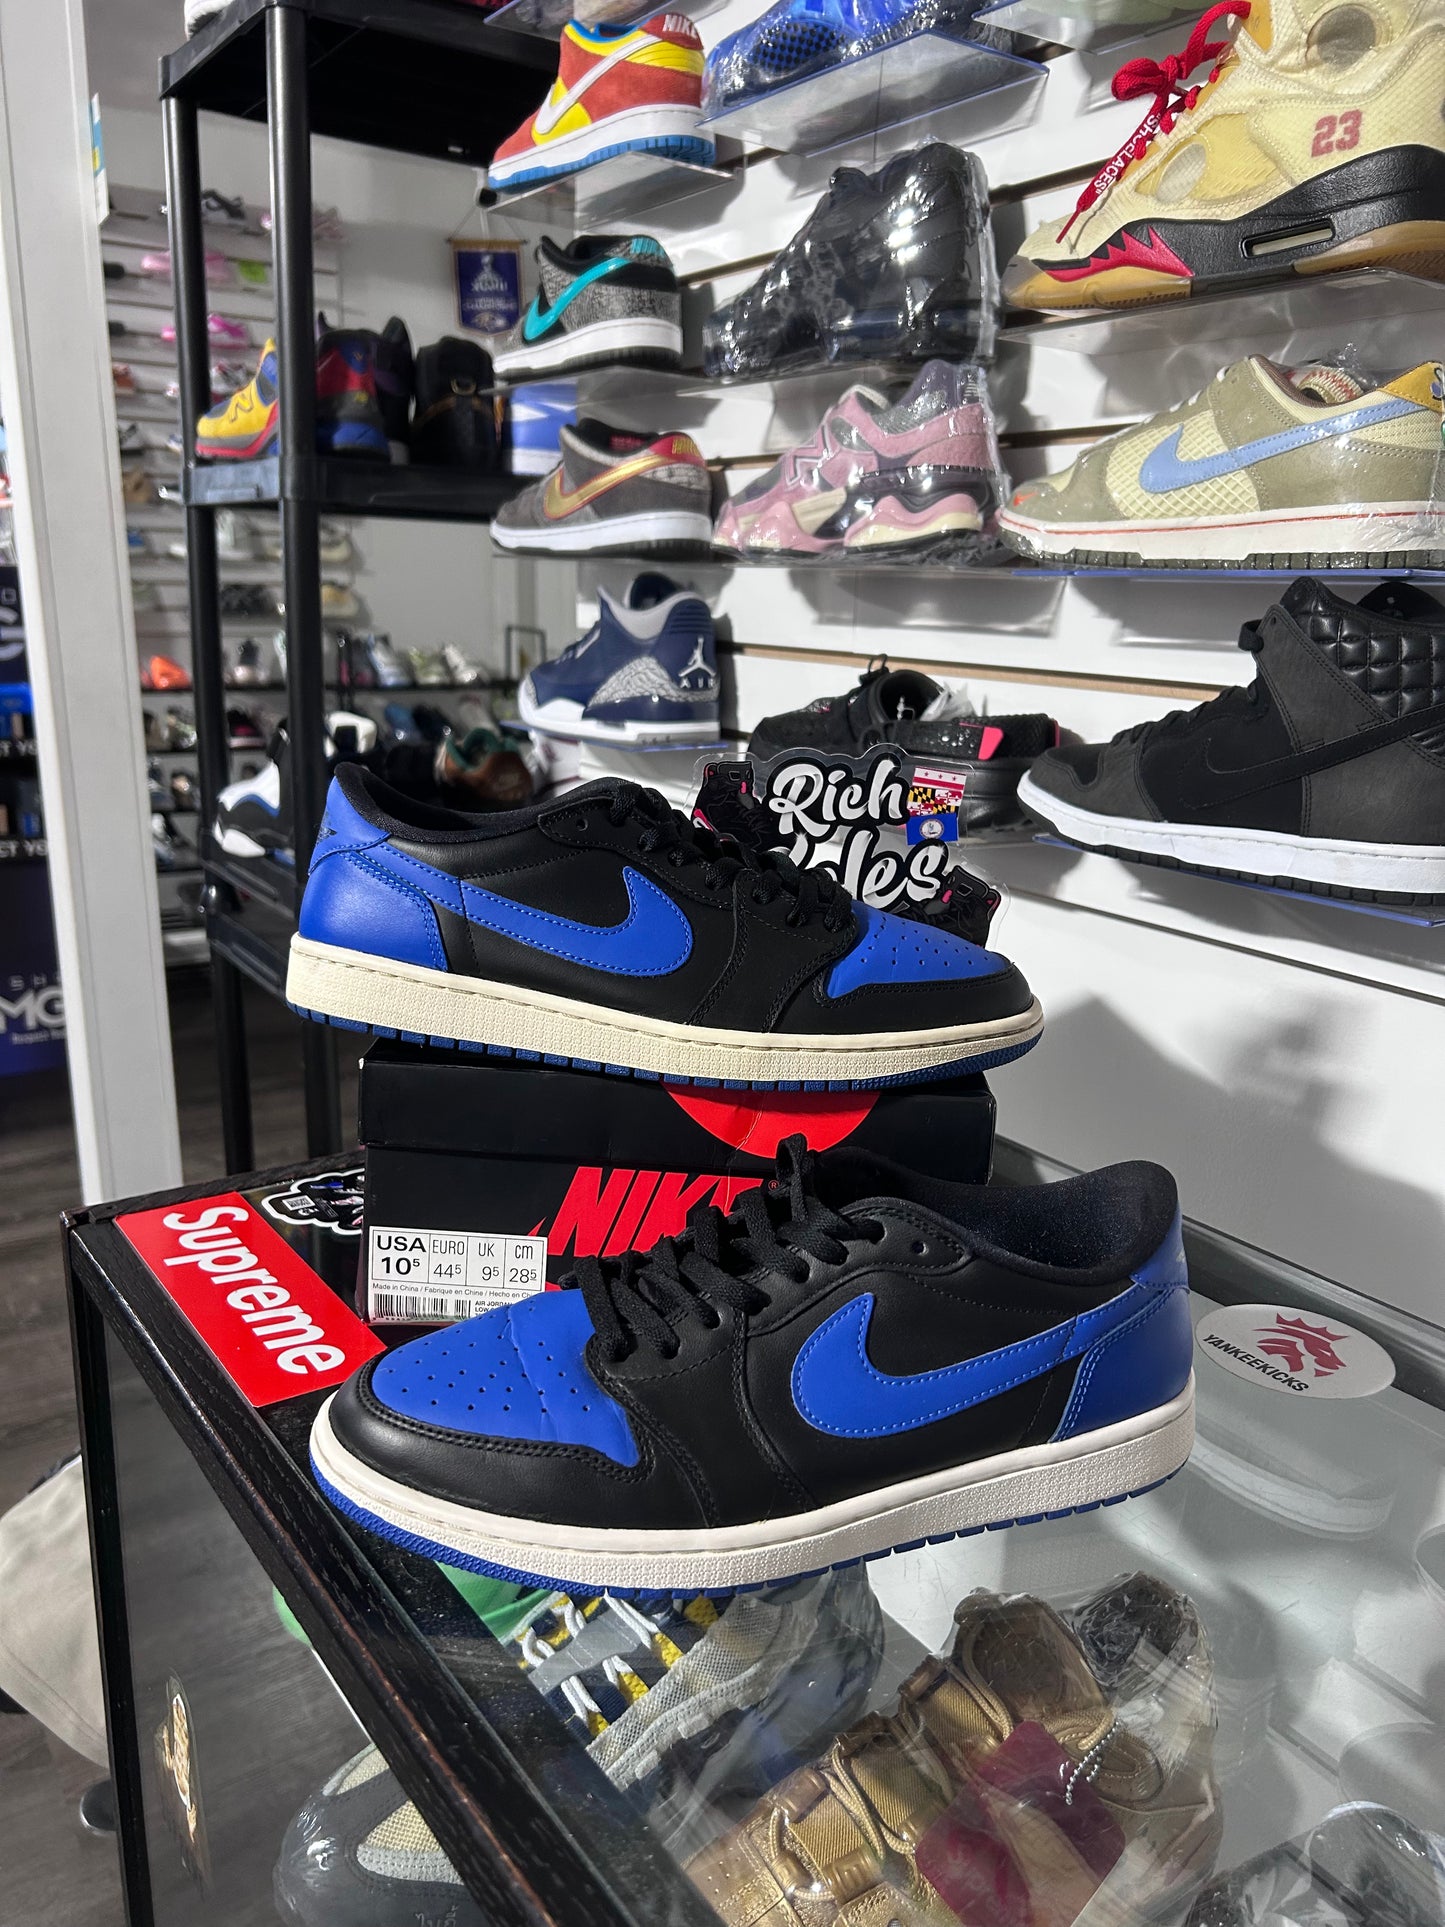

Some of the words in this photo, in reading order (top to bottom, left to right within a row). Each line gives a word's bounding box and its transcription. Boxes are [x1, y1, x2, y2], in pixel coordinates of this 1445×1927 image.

[1310, 108, 1363, 158] 23
[768, 758, 903, 838] Rich
[376, 1234, 427, 1253] USA
[432, 1239, 465, 1256] EURO
[478, 1242, 495, 1258] UK
[514, 1244, 534, 1260] cm
[162, 1205, 346, 1375] Supreme
[372, 1282, 391, 1290] Made
[400, 1284, 419, 1292] China
[424, 1286, 453, 1295] Fabrique
[464, 1289, 484, 1297] Chine
[489, 1290, 510, 1299] Hecho
[1202, 1333, 1310, 1392] YANKEEKICKS
